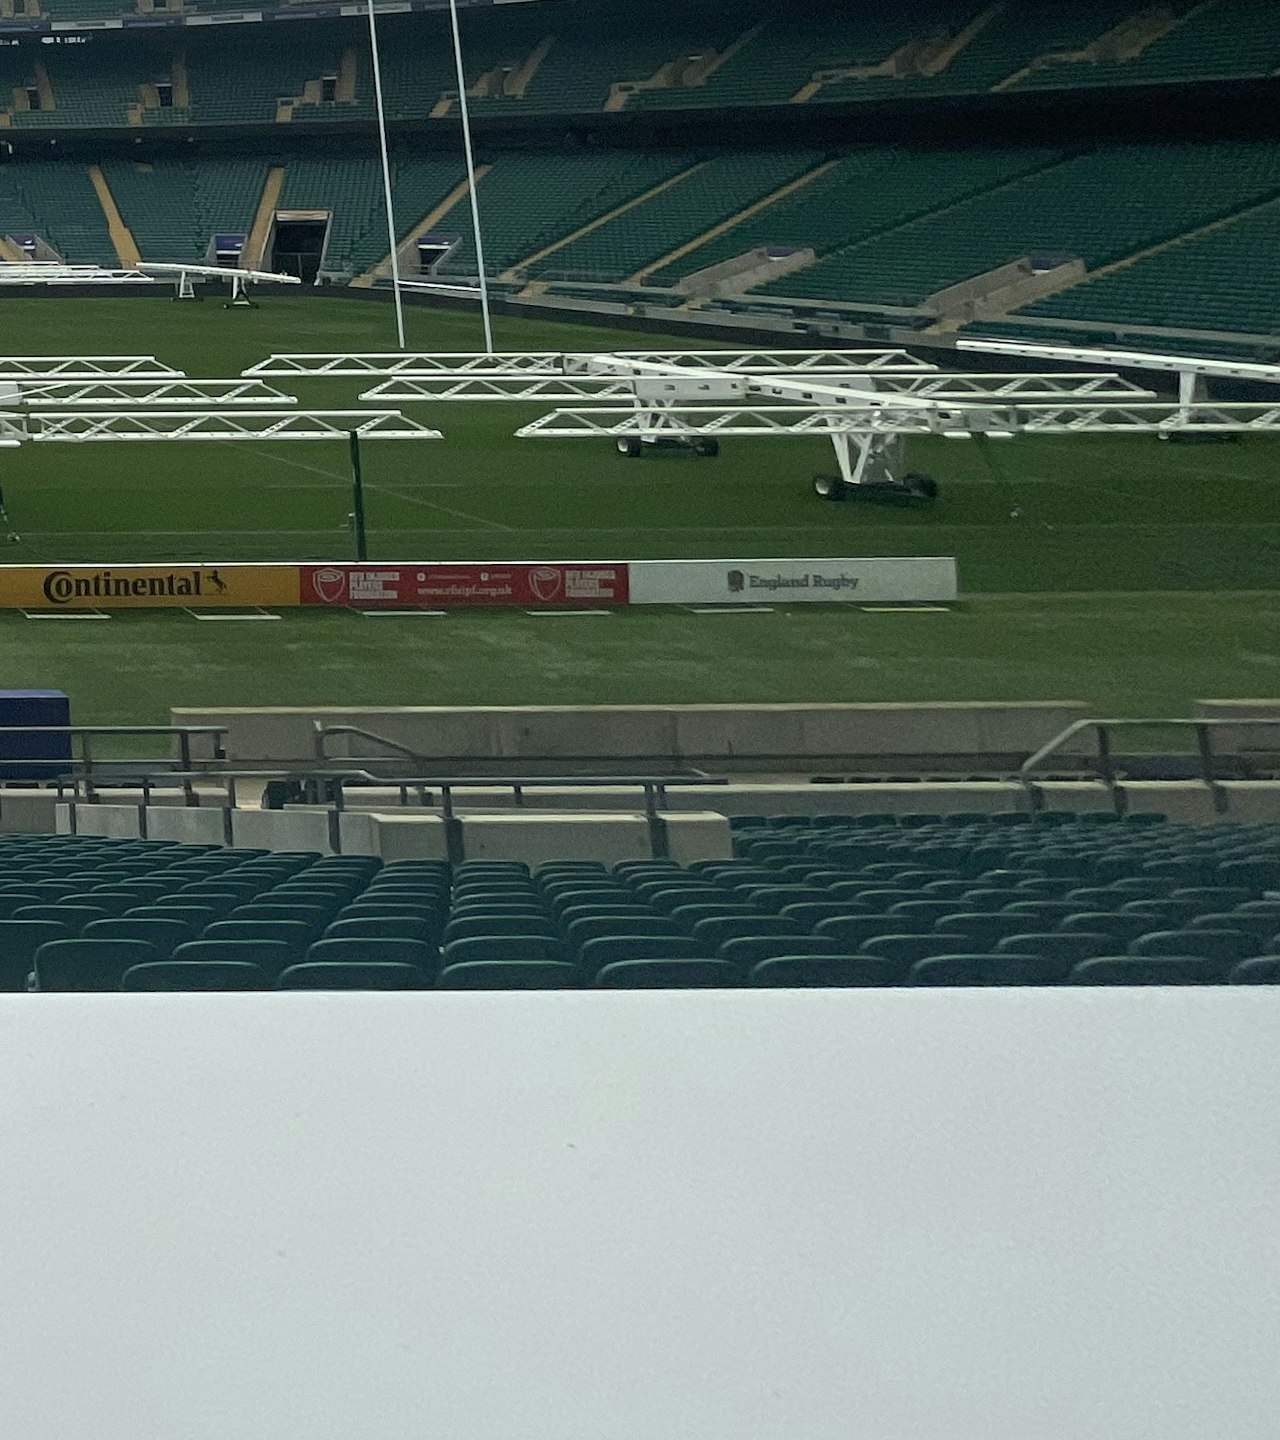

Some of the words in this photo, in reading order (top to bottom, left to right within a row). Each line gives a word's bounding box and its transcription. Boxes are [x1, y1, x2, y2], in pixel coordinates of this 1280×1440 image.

[43, 571, 202, 604] Continental
[749, 574, 809, 590] England
[813, 573, 859, 590] Rugby
